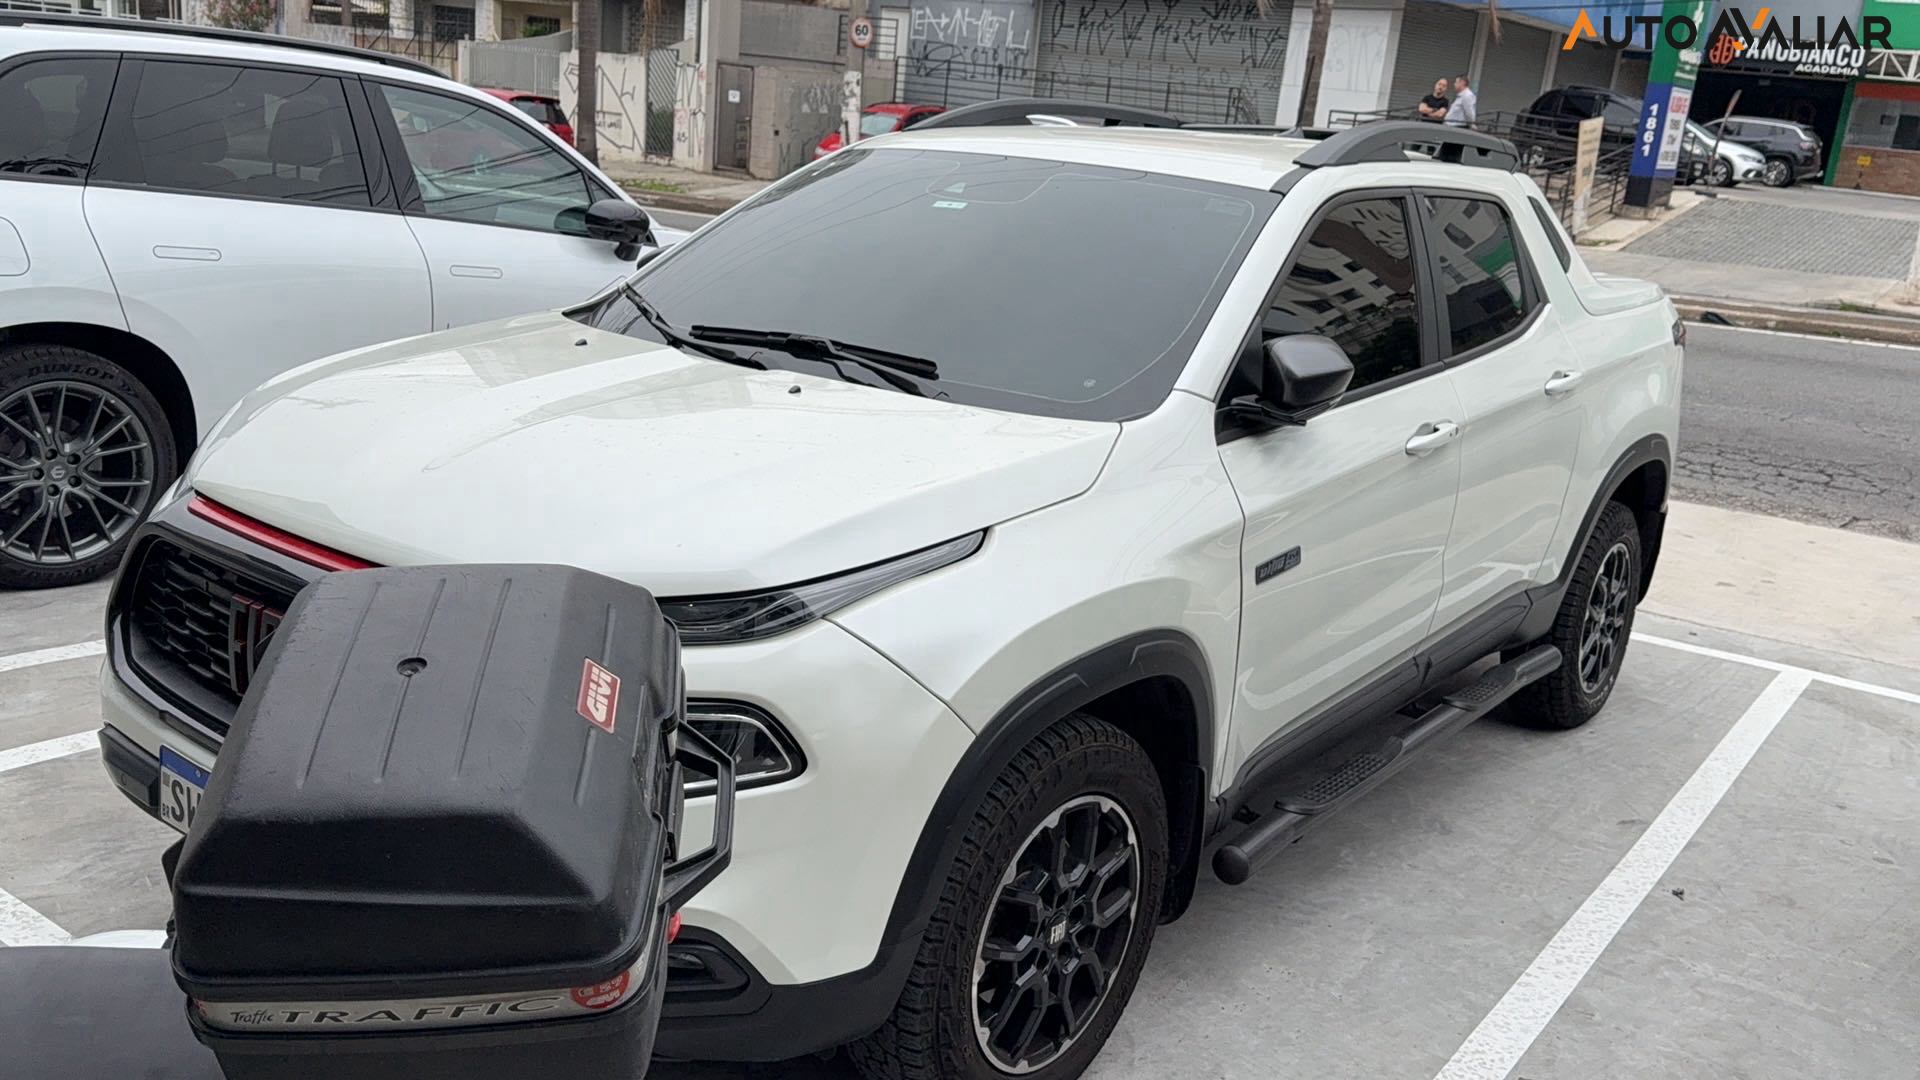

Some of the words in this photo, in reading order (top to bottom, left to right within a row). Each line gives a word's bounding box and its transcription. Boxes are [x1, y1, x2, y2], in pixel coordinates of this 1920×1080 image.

[855, 24, 868, 36] 60
[1795, 63, 1859, 76] ACADEMIA
[1641, 103, 1659, 157] 1861
[28, 363, 115, 379] DUNLOP
[586, 665, 612, 722] GIVI
[230, 1008, 275, 1024] Traffic
[281, 996, 563, 1024] TRAFFIC
